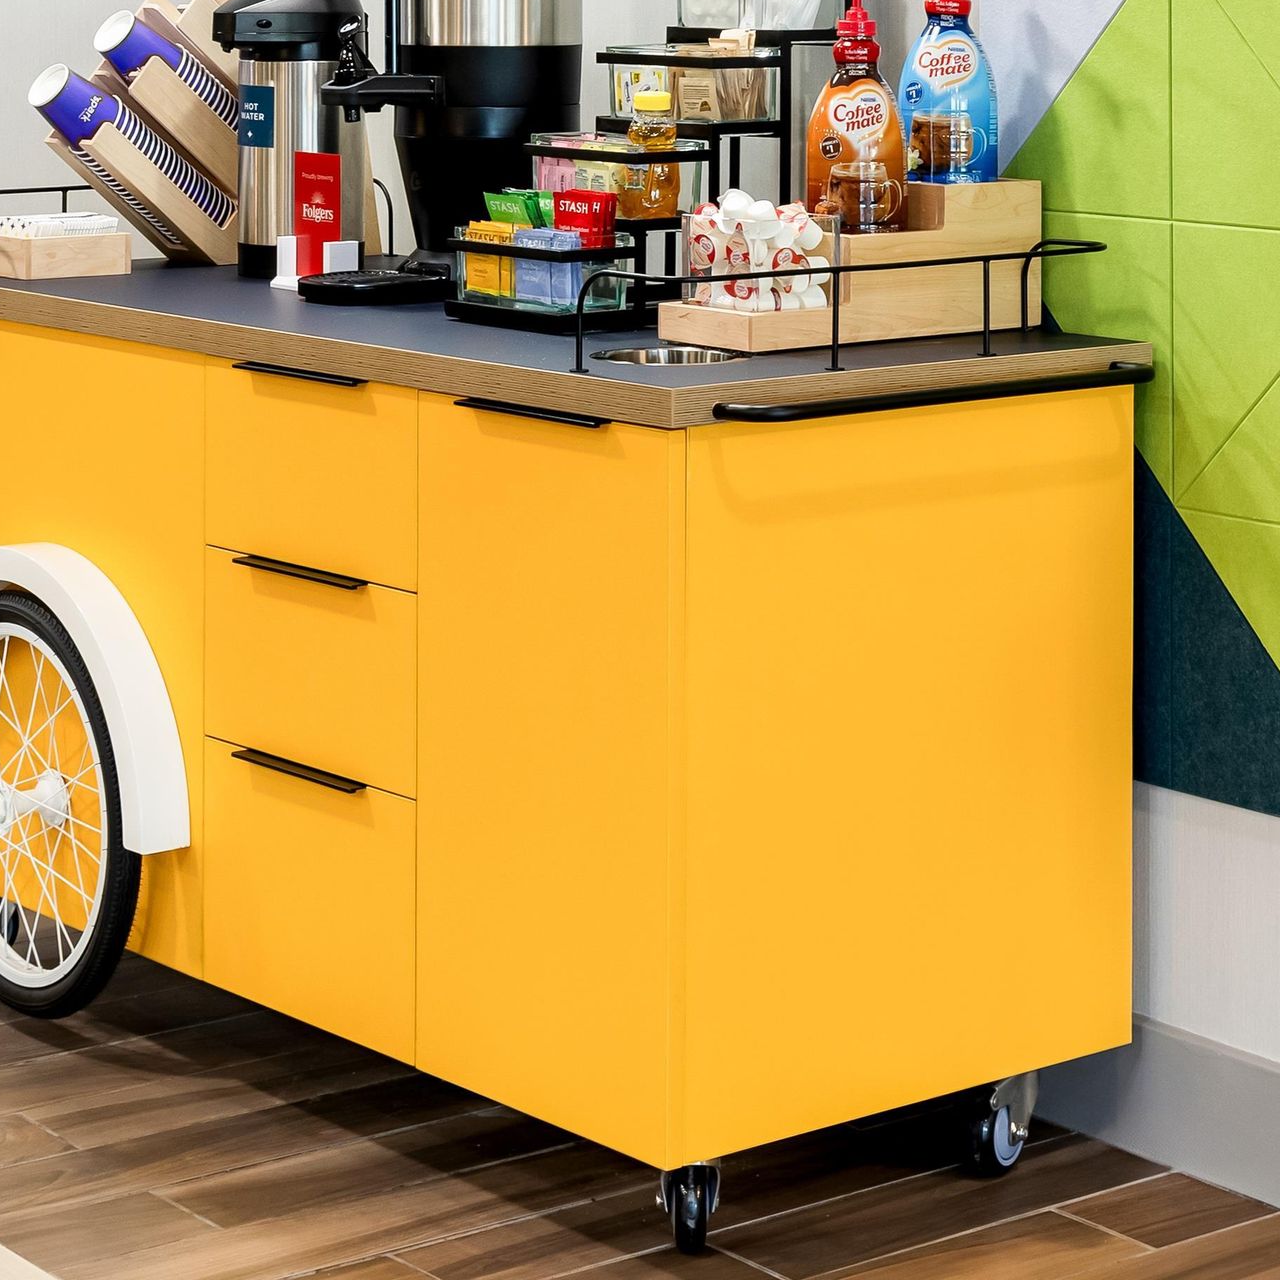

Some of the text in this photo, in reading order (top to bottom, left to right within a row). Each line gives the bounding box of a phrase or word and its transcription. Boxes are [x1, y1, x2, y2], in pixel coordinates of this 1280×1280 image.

[918, 51, 971, 69] Coffee
[928, 62, 972, 78] mate
[80, 95, 103, 123] spark
[243, 102, 259, 111] HOT
[833, 102, 882, 122] Coffee
[240, 111, 265, 121] WATER
[845, 112, 884, 132] mate
[302, 203, 334, 223] Folgers
[490, 200, 521, 213] STASH
[559, 200, 589, 214] STASH
